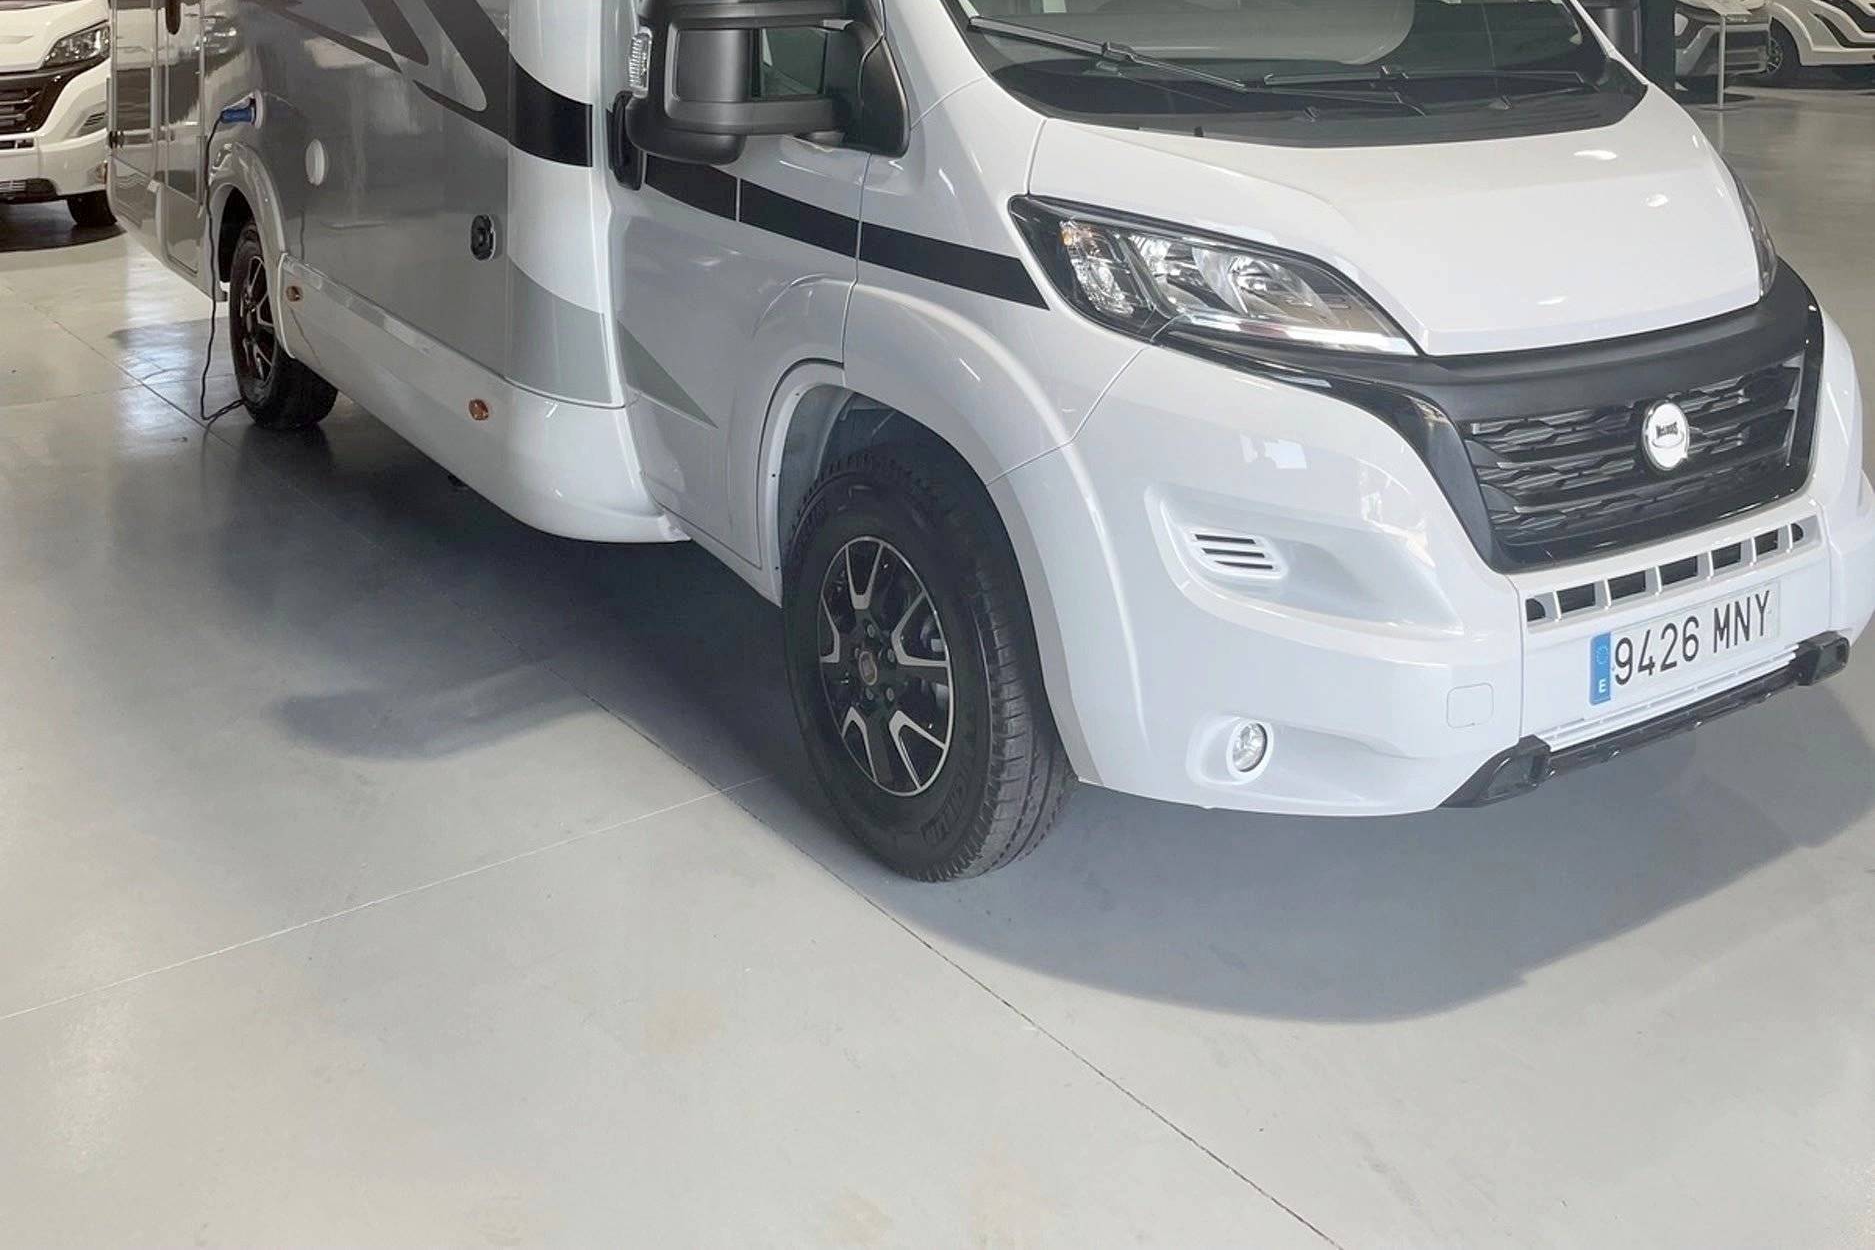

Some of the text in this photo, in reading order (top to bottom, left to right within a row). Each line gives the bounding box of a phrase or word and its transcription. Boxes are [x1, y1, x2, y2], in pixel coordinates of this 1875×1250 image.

[1614, 590, 1770, 685] 9426 MNY
[1599, 678, 1608, 693] E
